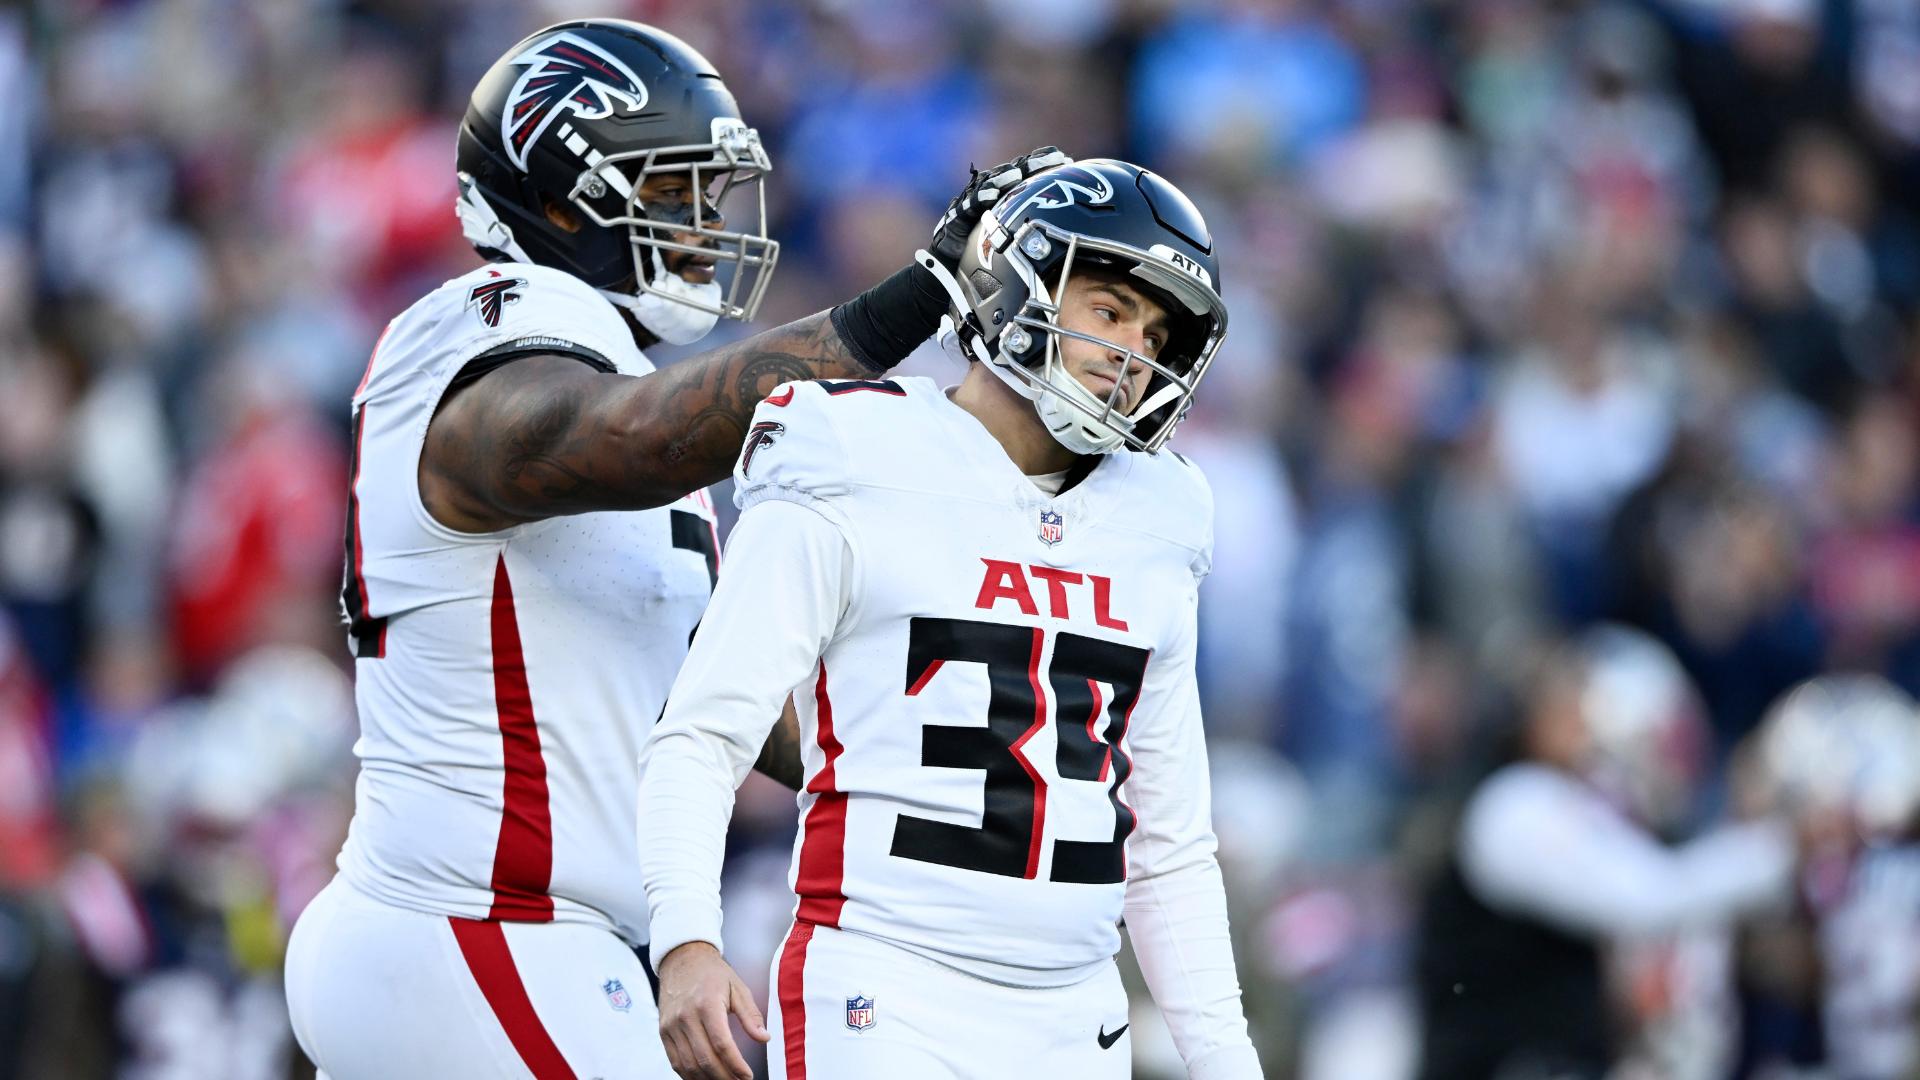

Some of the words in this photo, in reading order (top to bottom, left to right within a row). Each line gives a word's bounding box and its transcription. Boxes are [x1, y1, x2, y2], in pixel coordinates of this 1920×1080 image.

[1171, 252, 1203, 280] ATL
[515, 336, 574, 349] DOUGLAS
[1042, 524, 1061, 541] NFL
[975, 557, 1129, 632] ATL
[889, 616, 1151, 885] 39
[849, 1010, 872, 1025] NFL
